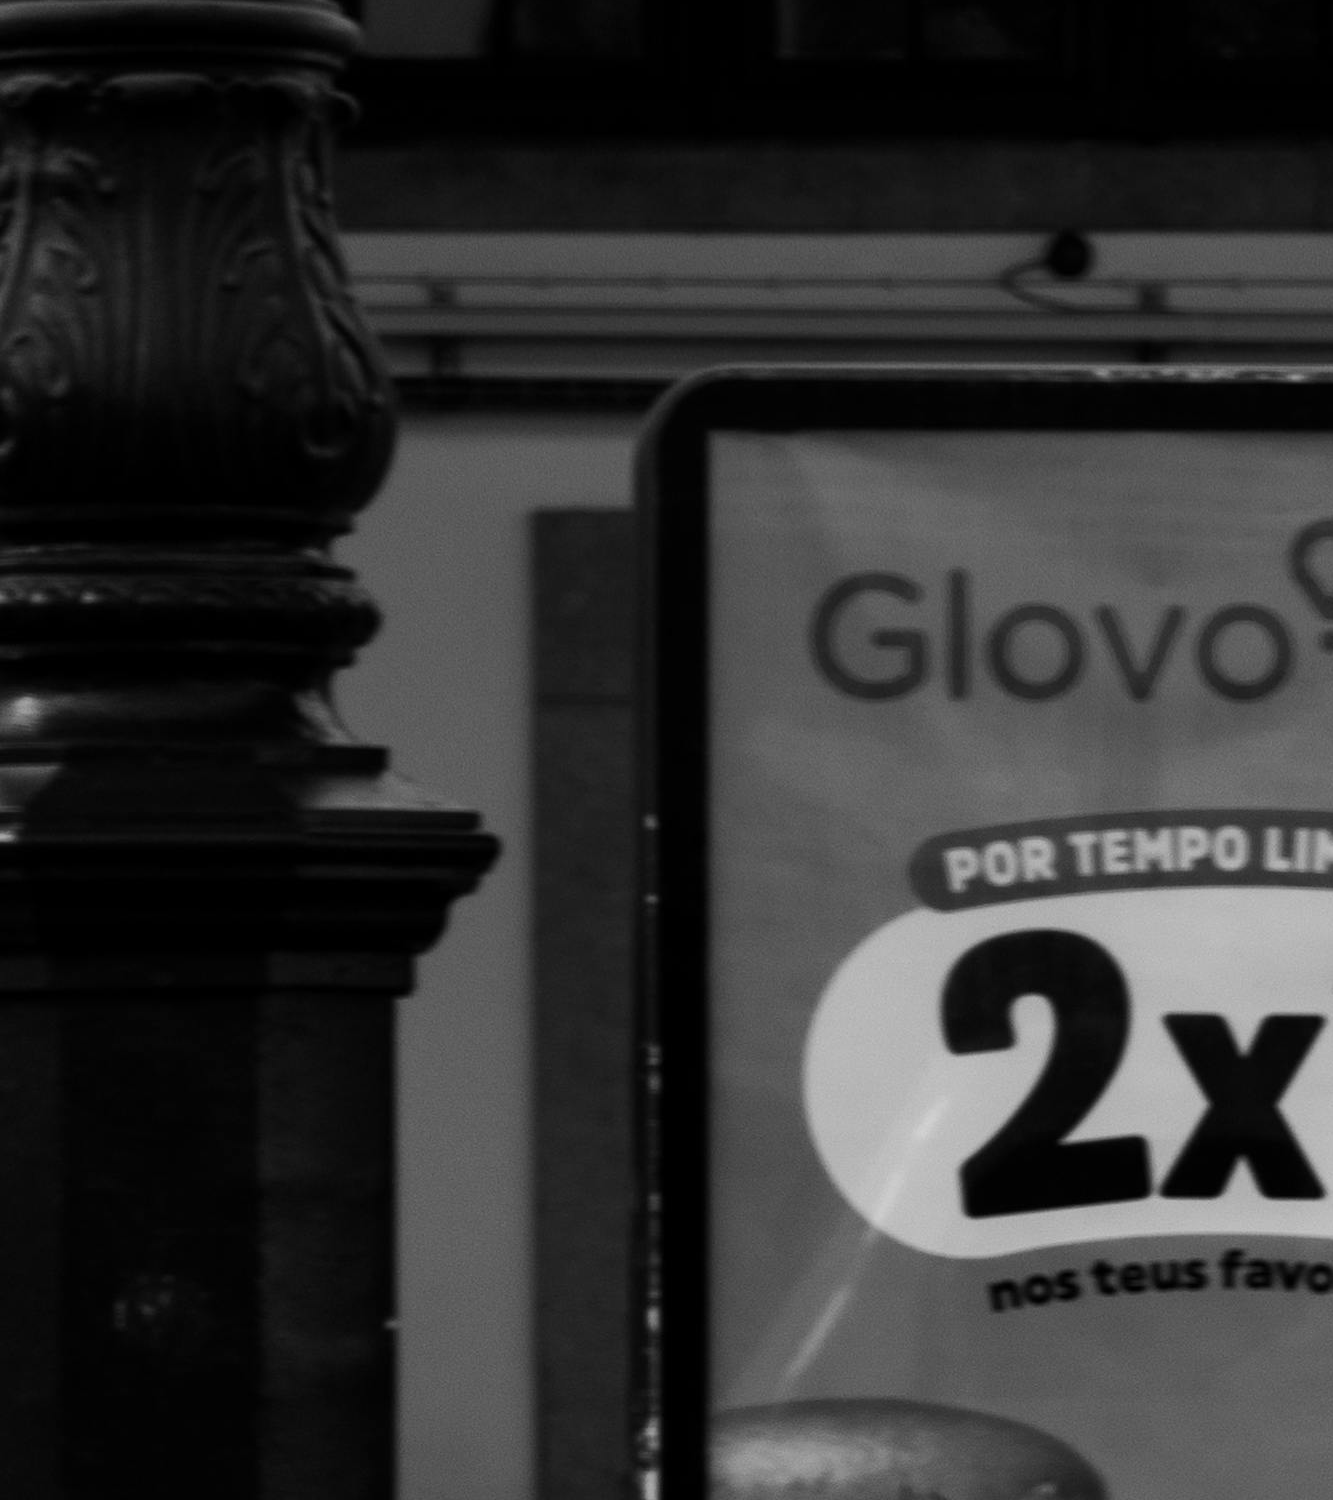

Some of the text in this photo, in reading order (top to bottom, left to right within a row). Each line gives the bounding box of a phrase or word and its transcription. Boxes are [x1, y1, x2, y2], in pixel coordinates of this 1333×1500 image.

[810, 568, 1293, 703] Glovo
[943, 836, 1058, 892] POR
[1066, 825, 1250, 877] TEMPO
[986, 1268, 1081, 1313] nos
[1090, 1257, 1209, 1296] teus
